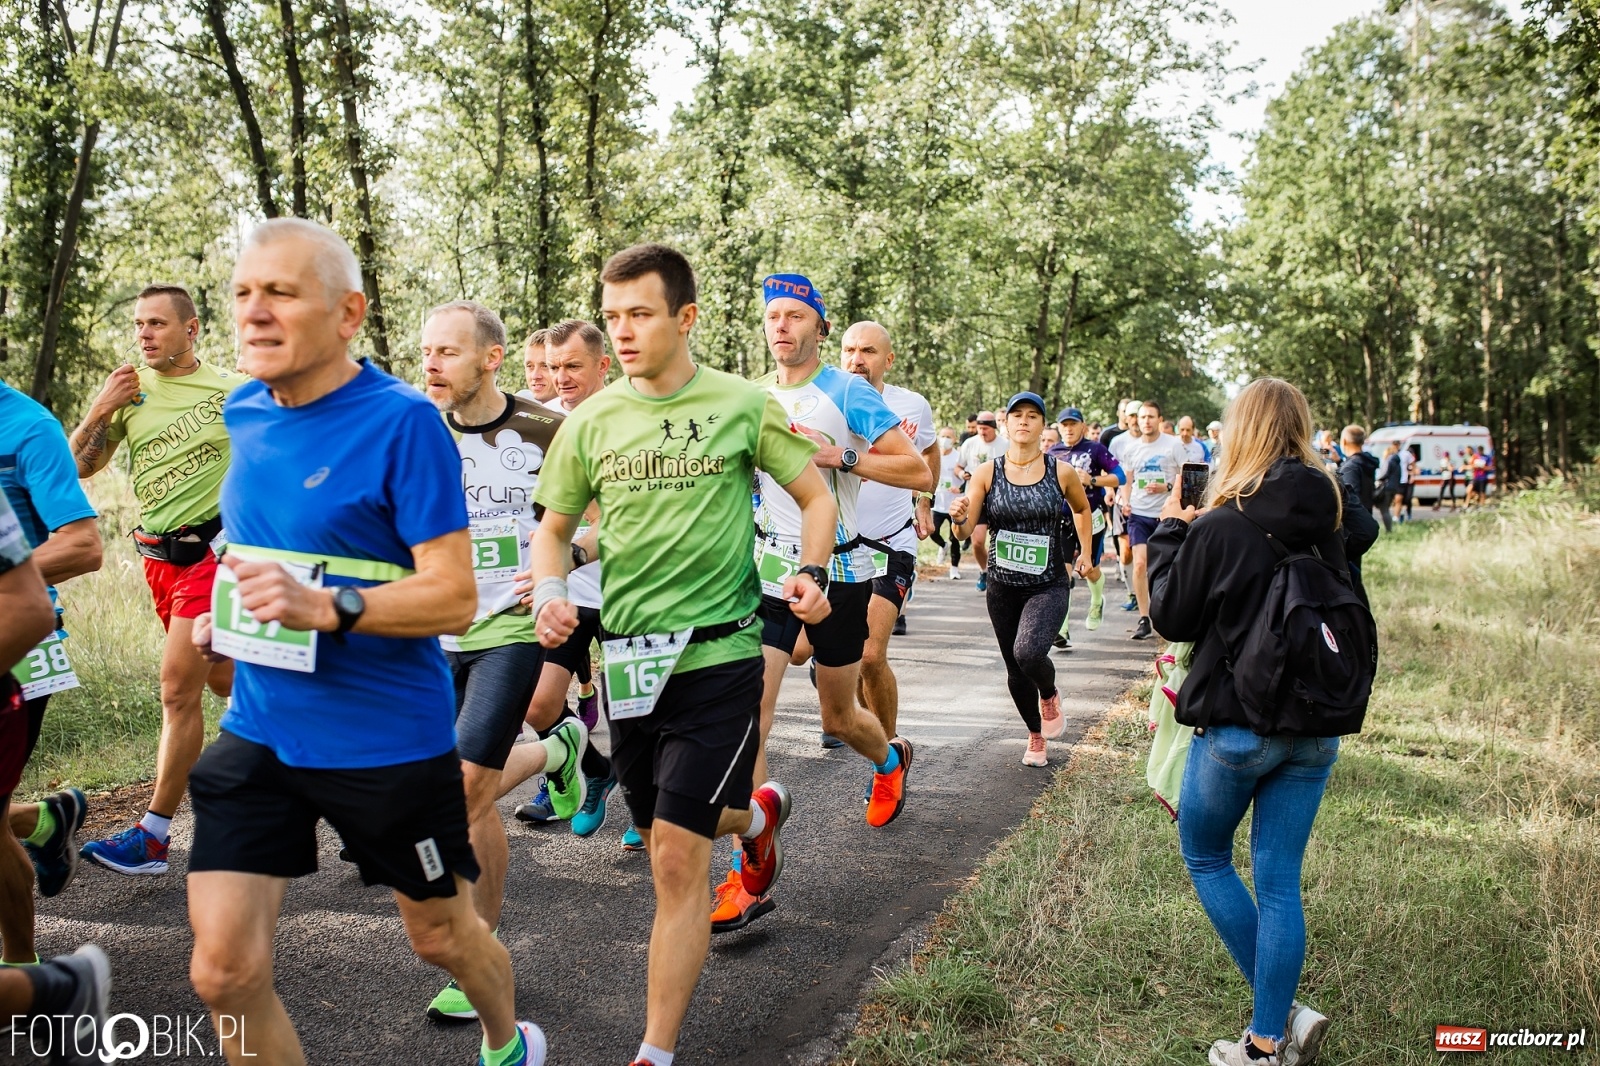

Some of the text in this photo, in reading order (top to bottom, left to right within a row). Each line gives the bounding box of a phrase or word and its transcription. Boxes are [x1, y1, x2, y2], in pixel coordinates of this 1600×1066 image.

[600, 449, 725, 482] Radlinioki
[647, 480, 696, 492] biegu
[1005, 543, 1037, 564] 106
[776, 561, 801, 584] 2
[26, 642, 71, 679] 38
